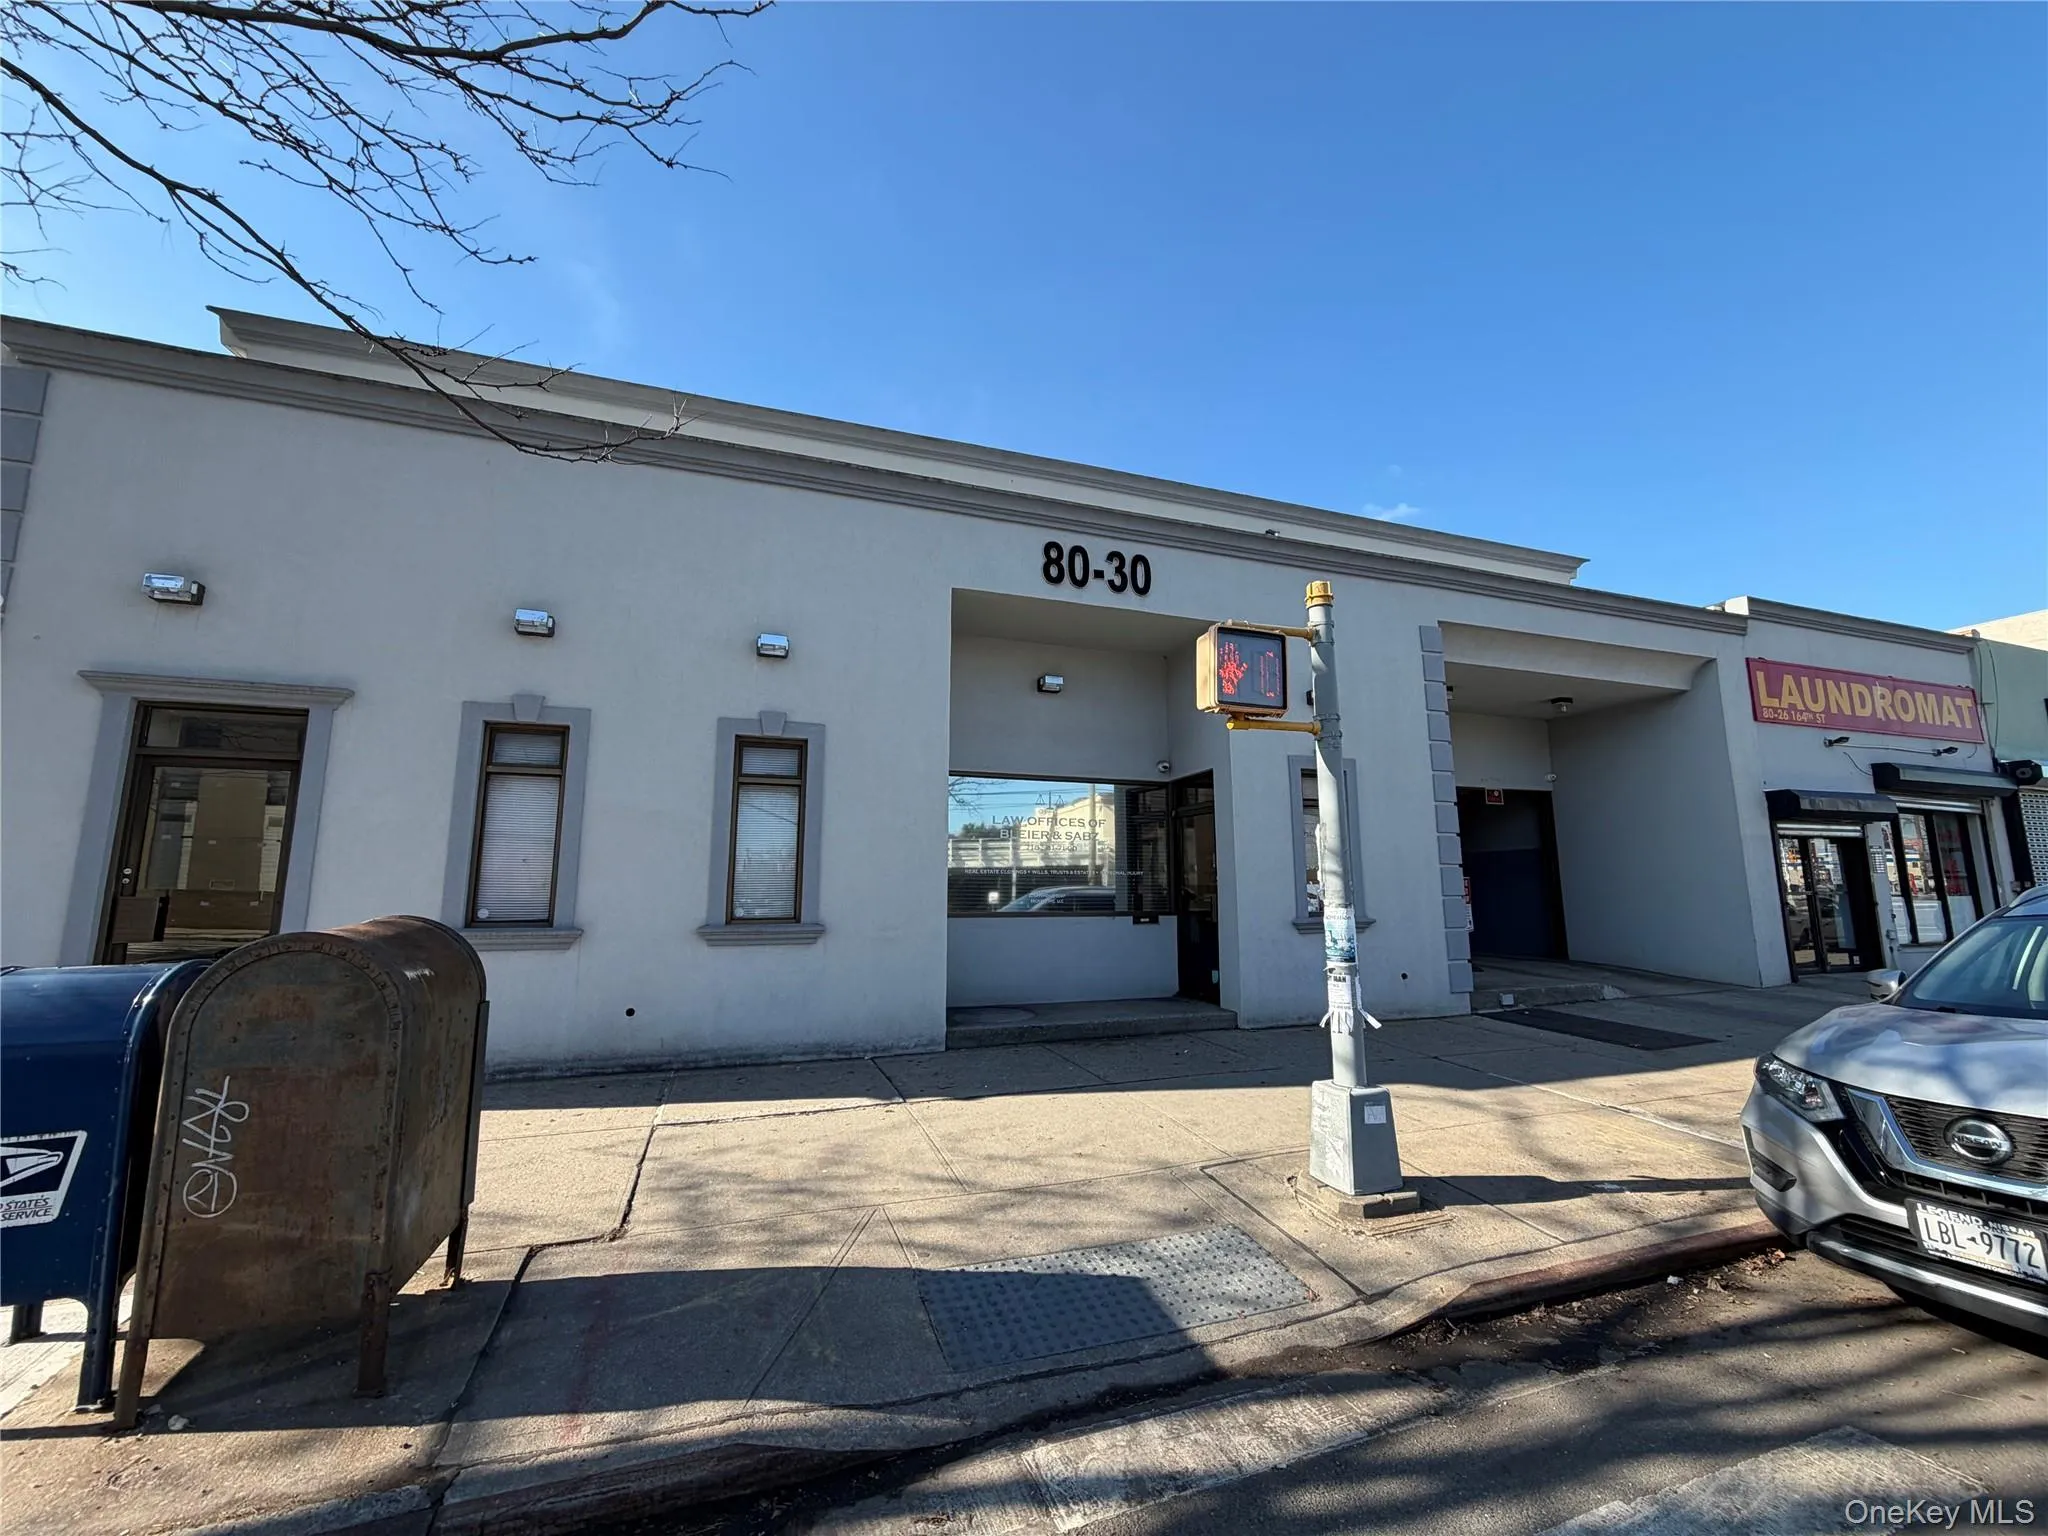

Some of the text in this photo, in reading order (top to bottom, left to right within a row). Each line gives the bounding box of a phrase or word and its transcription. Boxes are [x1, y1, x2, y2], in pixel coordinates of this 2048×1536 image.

[1042, 541, 1152, 596] 80-30
[1756, 671, 1973, 729] LAUNDROMAT
[1762, 707, 1789, 721] 80-26
[1816, 713, 1826, 724] ST
[992, 815, 1107, 828] LAW OFFICES OF
[1052, 830, 1062, 840] &
[1952, 1134, 2002, 1149] NISSAN
[6, 1197, 51, 1211] STATES
[1, 1207, 53, 1221] SERVICE
[1916, 1202, 1984, 1226] LEGEND
[1923, 1217, 1967, 1250] LBL
[1979, 1231, 2041, 1269] 9772
